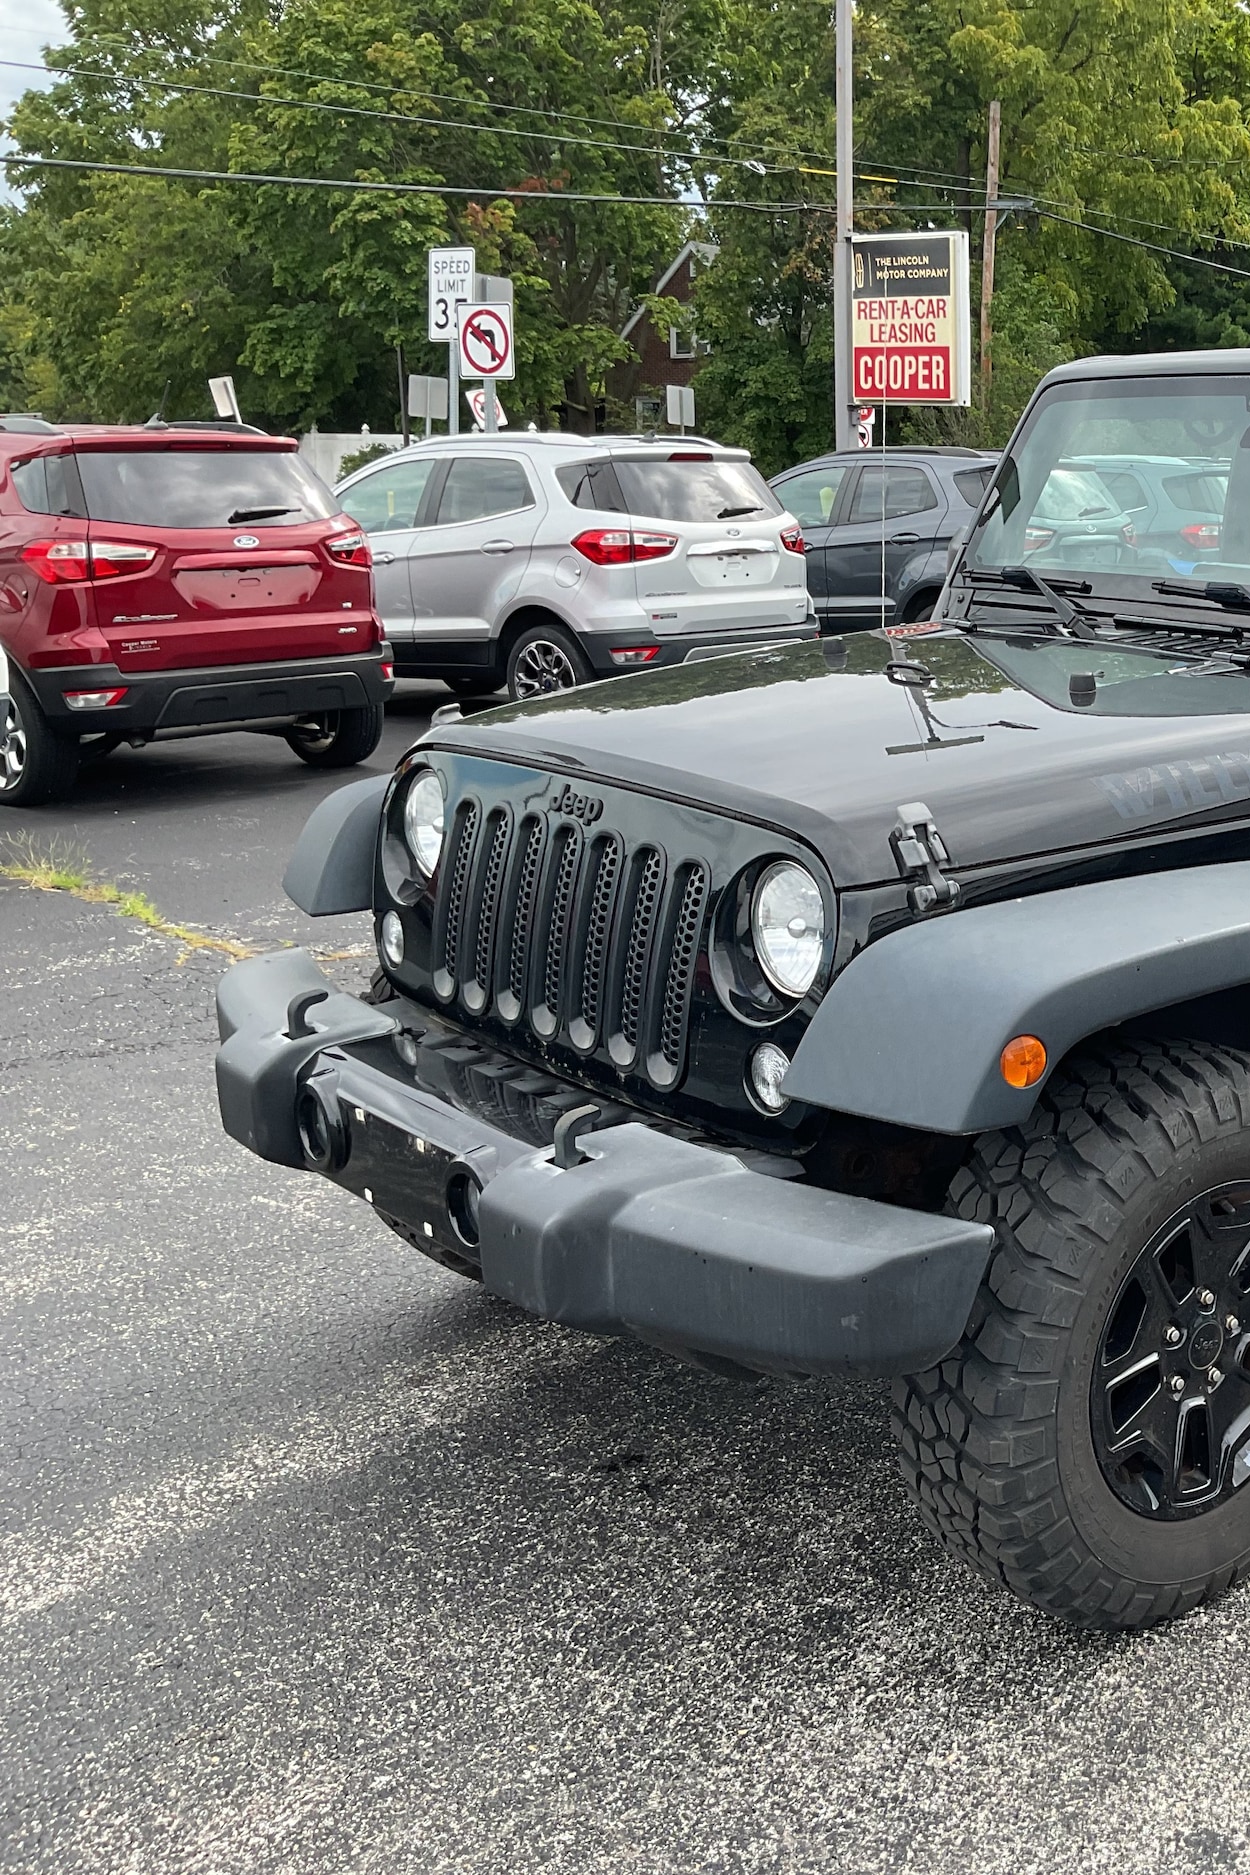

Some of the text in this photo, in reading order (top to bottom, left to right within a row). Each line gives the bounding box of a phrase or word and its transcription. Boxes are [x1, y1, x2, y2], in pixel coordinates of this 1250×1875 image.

[434, 260, 470, 275] SPEED
[875, 255, 929, 267] THE LINCOLN
[876, 268, 949, 280] MOTOR COMPANY
[437, 280, 466, 293] LIMIT
[857, 298, 947, 320] RENT-A-CAR
[869, 322, 936, 343] LEASING
[859, 355, 945, 390] COOPER
[550, 783, 604, 826] Jeep
